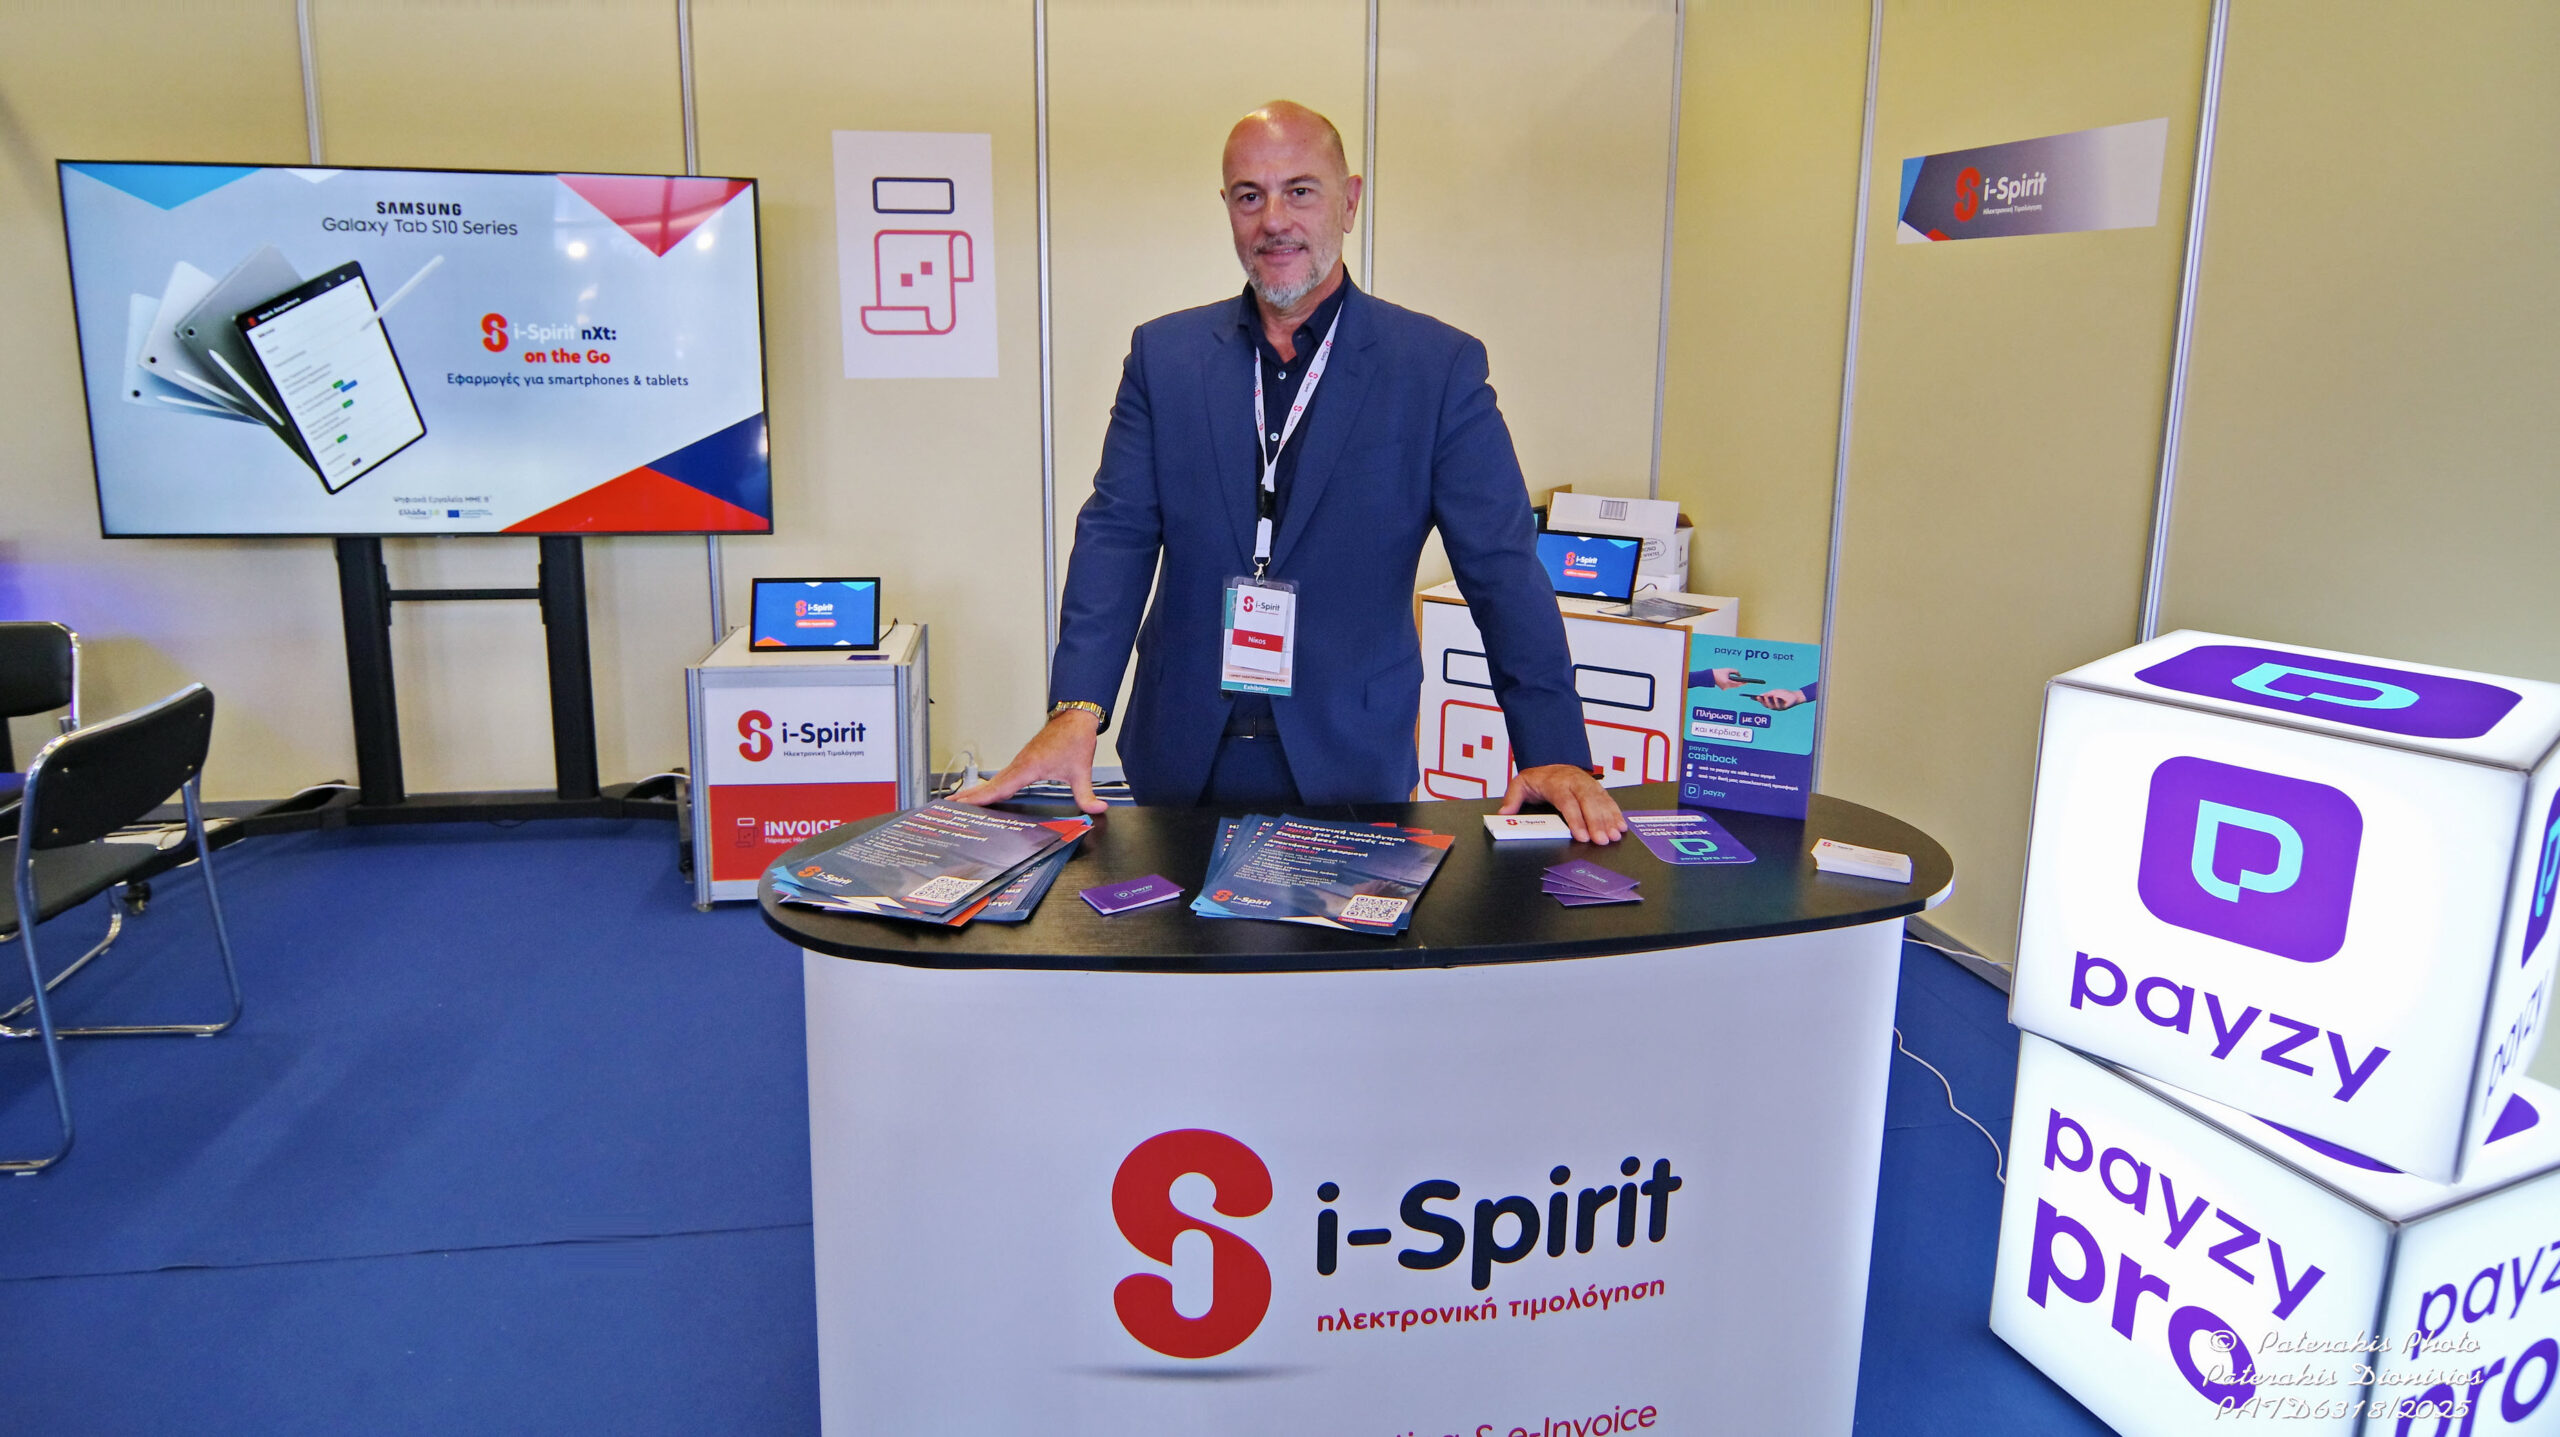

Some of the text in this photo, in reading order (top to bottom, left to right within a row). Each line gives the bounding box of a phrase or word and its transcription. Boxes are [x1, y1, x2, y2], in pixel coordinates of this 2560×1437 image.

[1983, 171, 2048, 206] i-Spirit
[376, 201, 462, 216] SAMSUNG
[322, 217, 518, 236] Galaxy Tab S10 Series
[514, 323, 617, 343] i-Spirit nXt:
[524, 348, 611, 363] on the Go
[447, 372, 689, 387] Εφαρμογές για smartphones & tablets
[1576, 555, 1598, 564] i-Spirit
[808, 603, 833, 612] i-Spirit
[1255, 602, 1280, 611] i-Spirit
[1714, 647, 1794, 661] payzy pro spot
[1243, 684, 1270, 692] Exhibitor
[1696, 708, 1768, 725] Πλήρωσε με QR
[782, 721, 867, 749] i-Spirit
[1694, 725, 1750, 738] και κέρδισε €
[783, 750, 826, 758] Ηλεκτρονική
[1688, 745, 1709, 753] payzy
[1688, 751, 1738, 765] cashback
[1703, 788, 1726, 798] payzy
[764, 819, 848, 836] iNVOICE
[1284, 821, 1347, 835] Ηλεκτρονική
[1643, 829, 1711, 837] cashback
[817, 871, 853, 885] i-Spirit
[1233, 894, 1272, 906] i-Spirit
[2070, 950, 2391, 1103] payzy
[2044, 1107, 2325, 1321] payzy
[1316, 1156, 1683, 1291] i-Spirit
[1317, 1278, 1666, 1333] ηλεκτρονική τιμολόγηση
[2027, 1196, 2257, 1412] pro
